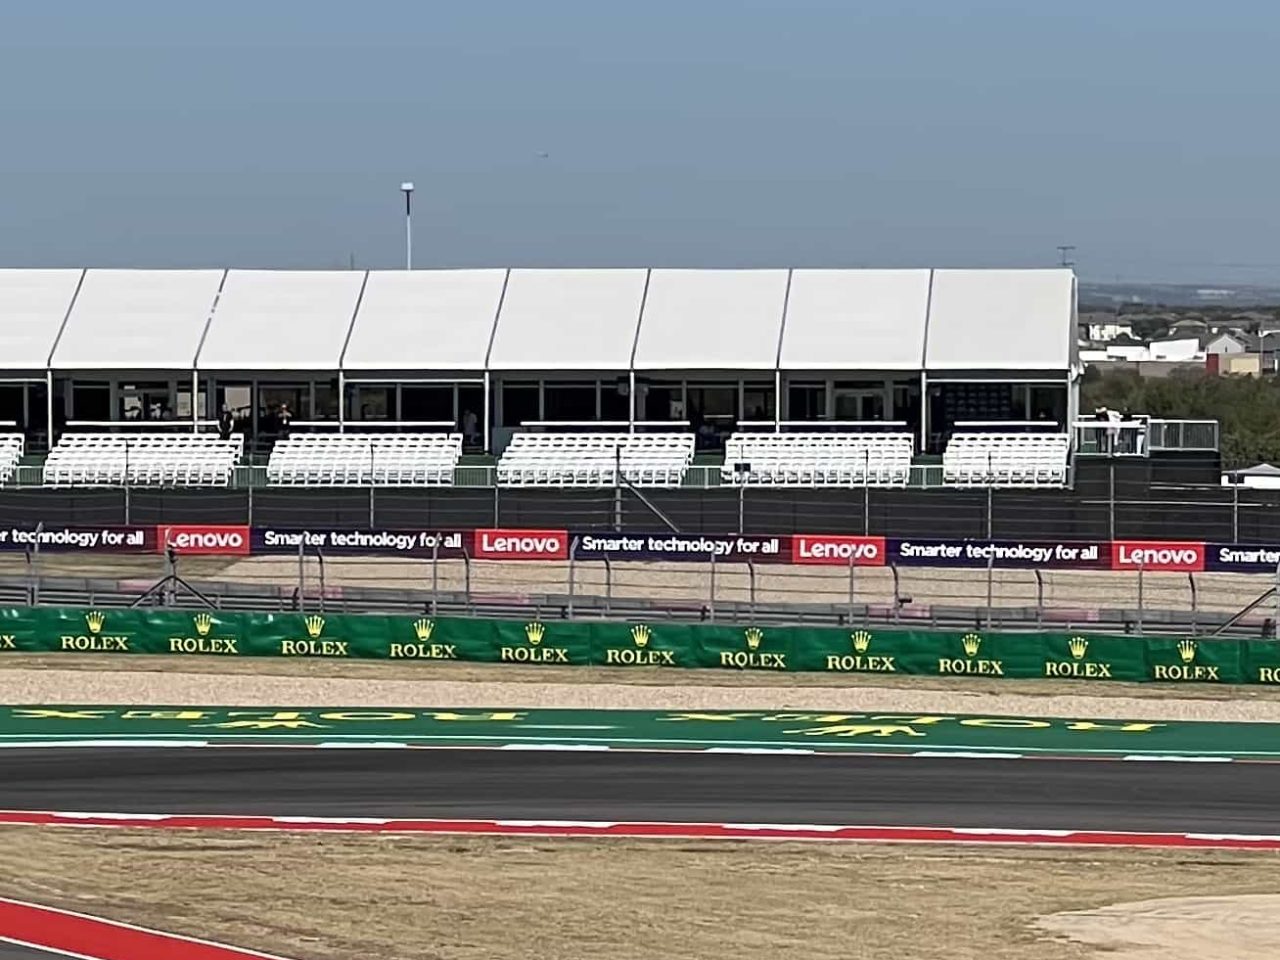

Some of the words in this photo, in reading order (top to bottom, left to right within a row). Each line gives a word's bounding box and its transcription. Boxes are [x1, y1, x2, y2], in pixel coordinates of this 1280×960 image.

[12, 525, 98, 551] technology
[102, 530, 124, 544] for
[123, 531, 143, 544] all
[265, 531, 326, 551] Smarter
[331, 532, 416, 549] technology
[440, 534, 461, 547] all
[479, 530, 563, 563] Lenovo
[583, 536, 644, 550] Smarter
[648, 534, 735, 559] technology
[737, 538, 758, 552] for
[757, 539, 778, 553] all
[797, 536, 880, 561] Lenovo
[900, 543, 962, 557] Smarter
[966, 544, 1052, 565] technology
[1056, 545, 1078, 559] for
[1078, 546, 1097, 559] all
[1117, 541, 1199, 564] Lenovo
[61, 635, 128, 650] ROLEX
[170, 638, 238, 653] ROLEX
[282, 640, 348, 656] ROLEX
[390, 643, 457, 658] ROLEX
[502, 646, 568, 662] ROLEX
[607, 649, 675, 664] ROLEX
[721, 652, 786, 667] ROLEX
[827, 655, 895, 671] ROLEX
[939, 658, 1004, 674] ROLEX
[1045, 662, 1112, 677] ROLEX
[1155, 665, 1219, 680] ROLEX
[12, 709, 530, 721] ROLEX
[656, 713, 1167, 731] ROLEX
